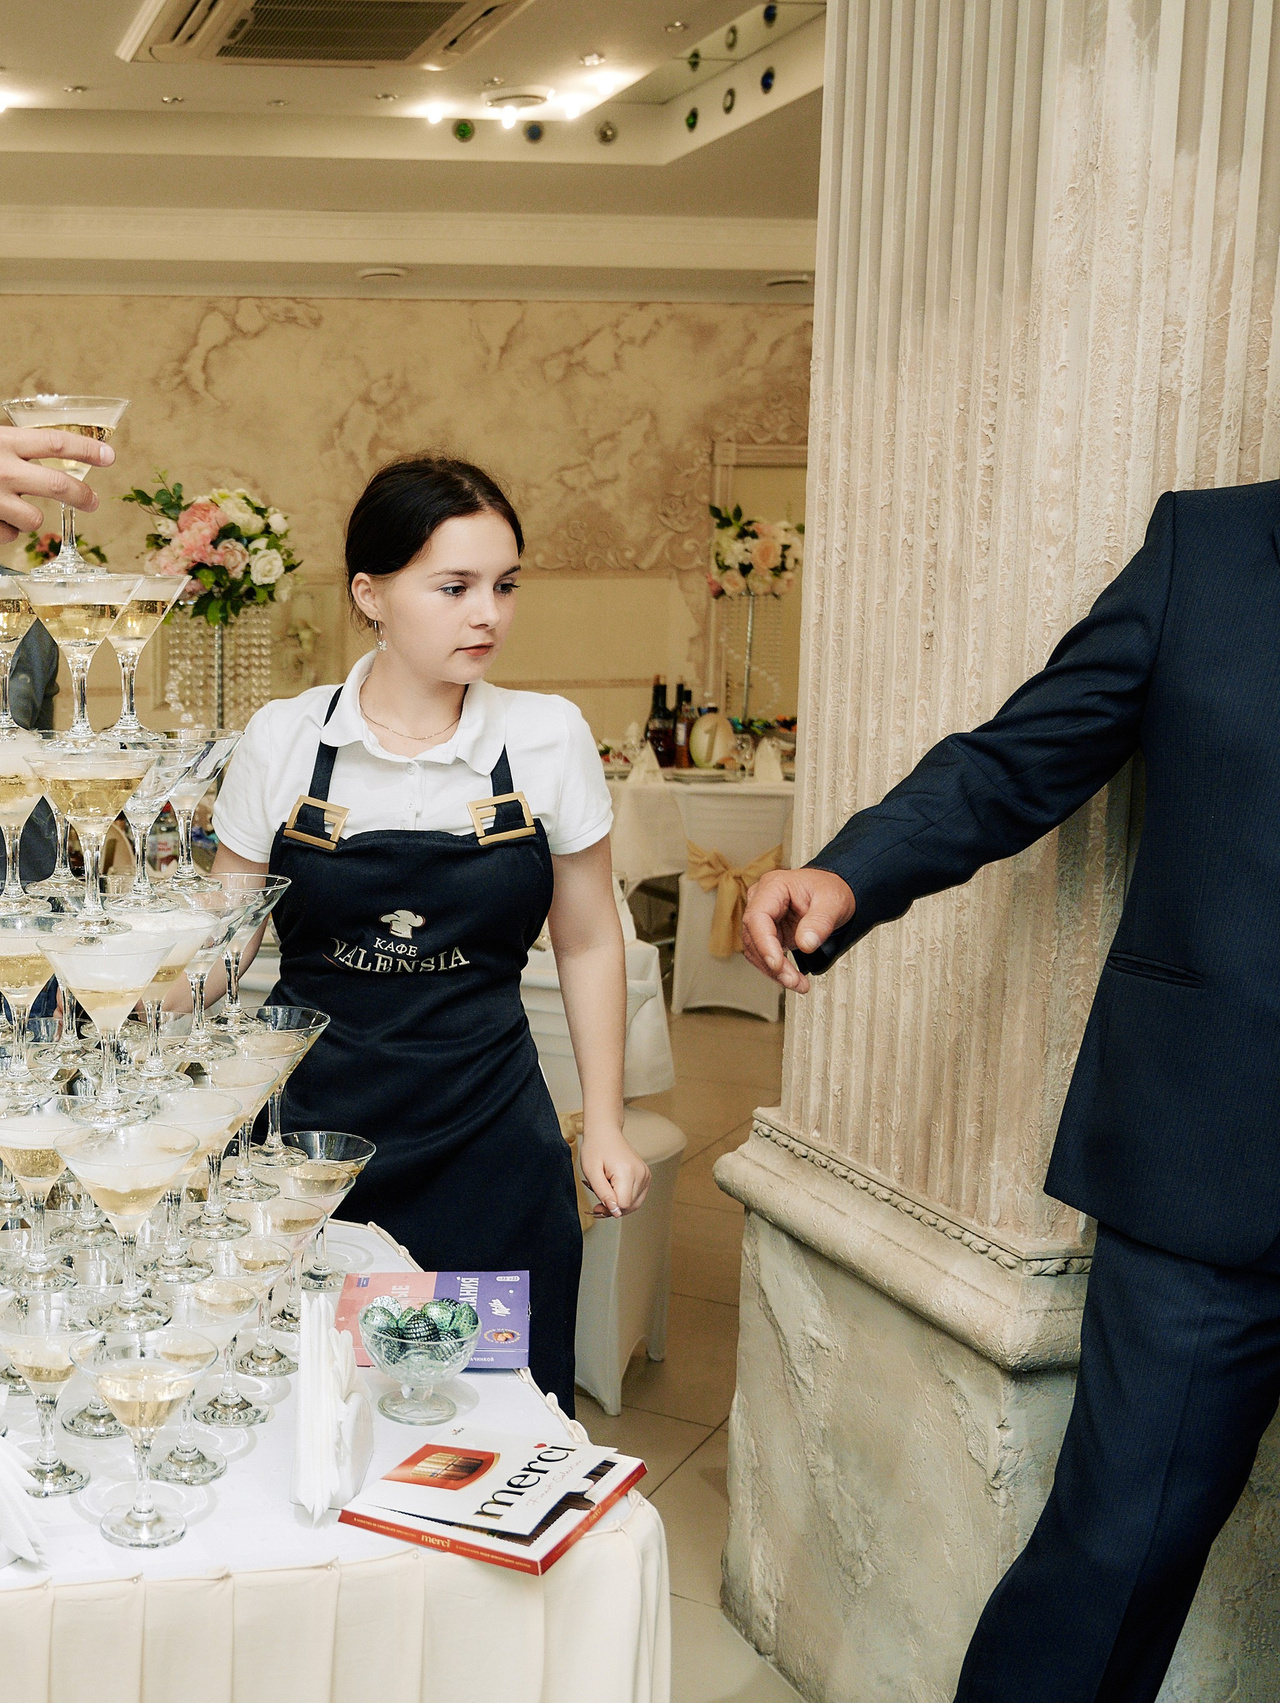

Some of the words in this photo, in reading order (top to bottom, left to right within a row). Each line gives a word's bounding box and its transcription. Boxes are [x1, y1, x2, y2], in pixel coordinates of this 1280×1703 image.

[330, 938, 470, 973] VALENSIA
[373, 937, 418, 957] КАФЕ
[473, 1443, 578, 1520] merci
[421, 1533, 450, 1548] merci
